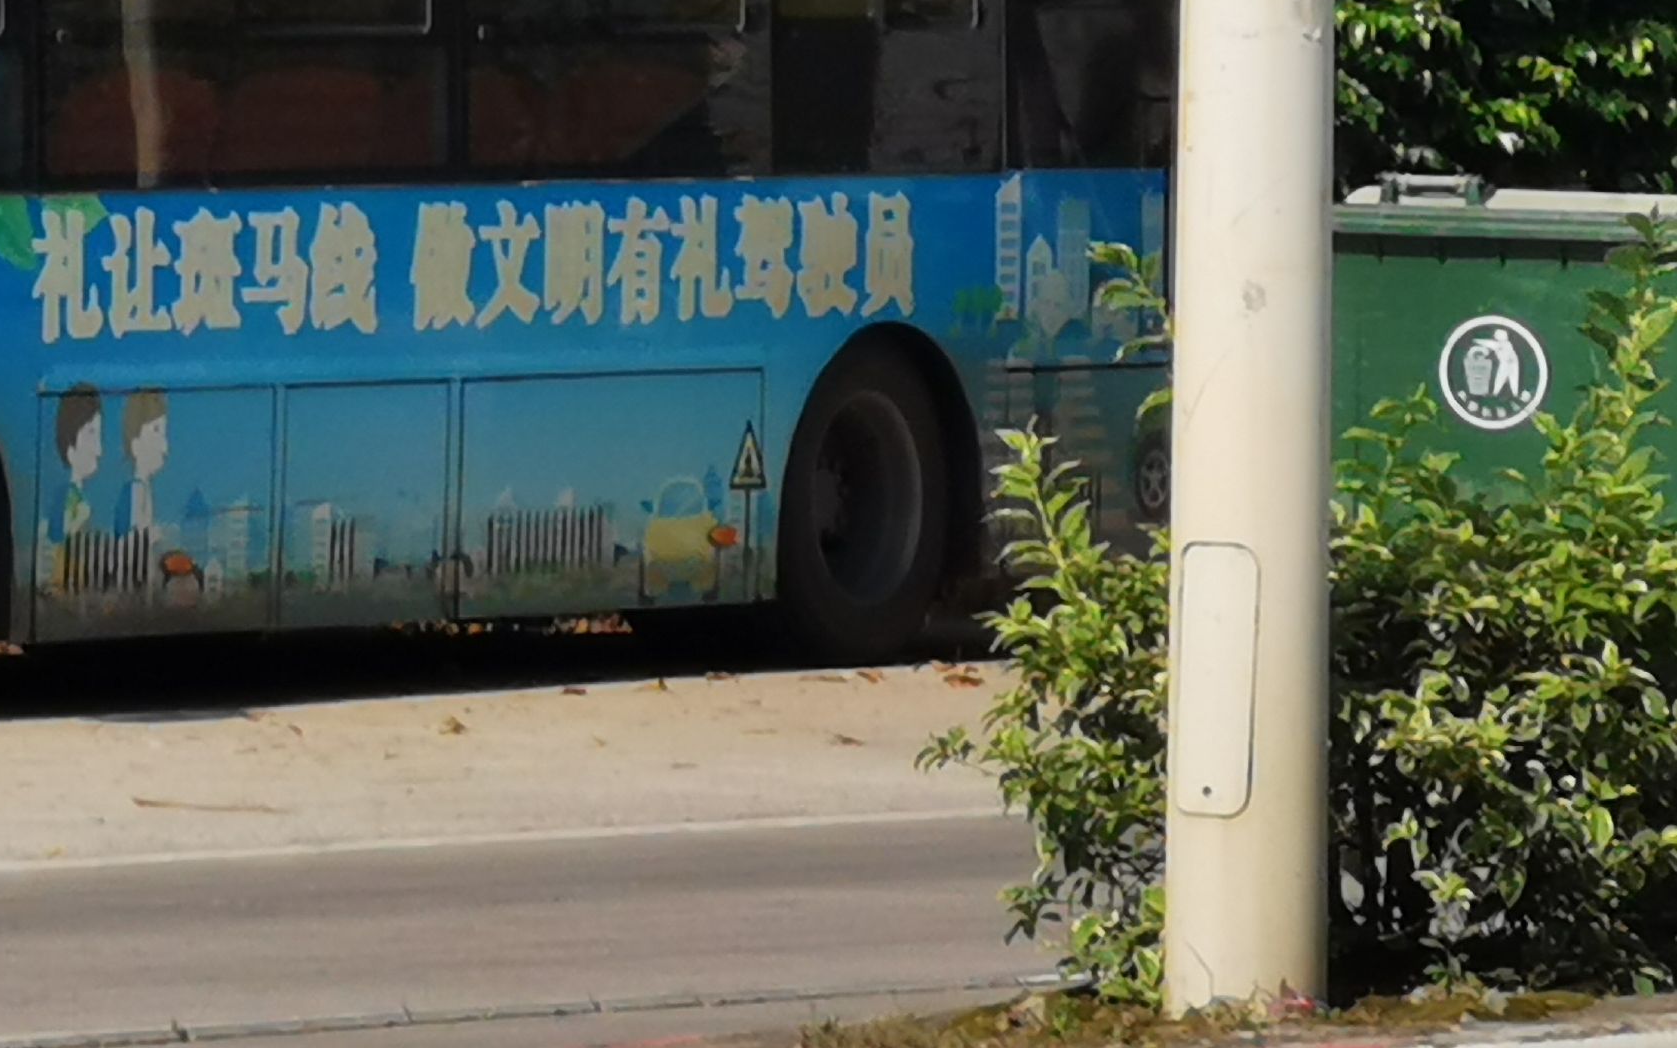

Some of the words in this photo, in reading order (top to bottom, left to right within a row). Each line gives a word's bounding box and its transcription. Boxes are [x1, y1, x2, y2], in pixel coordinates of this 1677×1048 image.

[31, 200, 379, 345] 礼让斑马线
[409, 191, 916, 331] 做文明有礼驾驶员
